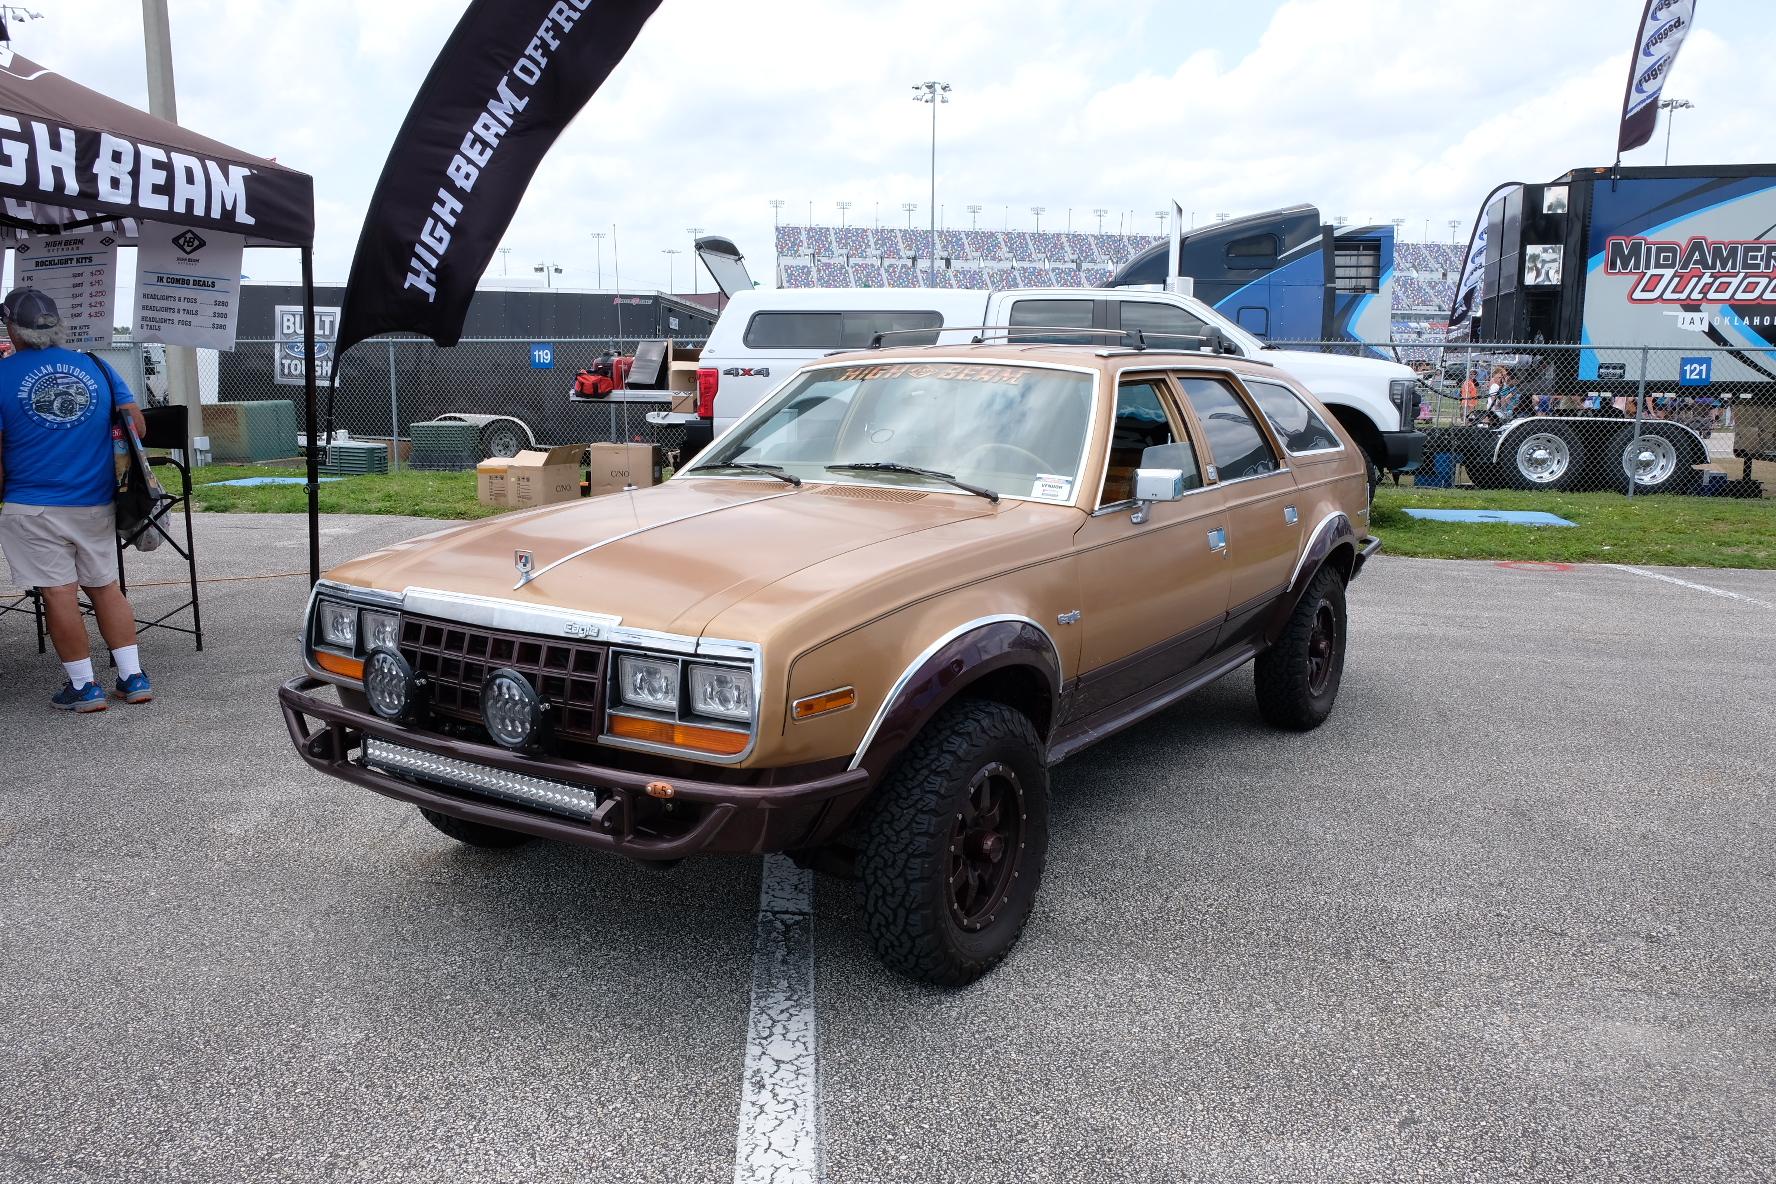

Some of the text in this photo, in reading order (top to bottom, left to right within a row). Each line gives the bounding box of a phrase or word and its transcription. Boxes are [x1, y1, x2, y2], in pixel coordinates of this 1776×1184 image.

[93, 132, 256, 226] BEAM
[403, 187, 463, 303] HIGH
[446, 75, 530, 193] BEAM
[34, 256, 93, 268] ROCKLIGHT KITS
[165, 276, 191, 286] COMBO
[192, 279, 216, 289] DEALS
[142, 293, 177, 302] HEADLIGHTS
[141, 305, 176, 314] HEADLIGHTS
[182, 308, 199, 316] TAILS
[282, 313, 334, 336] BULT
[1681, 315, 1776, 326] JAY OKLAHO
[533, 349, 551, 364] 119
[1683, 363, 1707, 379] 121
[18, 363, 98, 398] MAGELLAN OUTDOORS
[564, 622, 600, 638] Eagle
